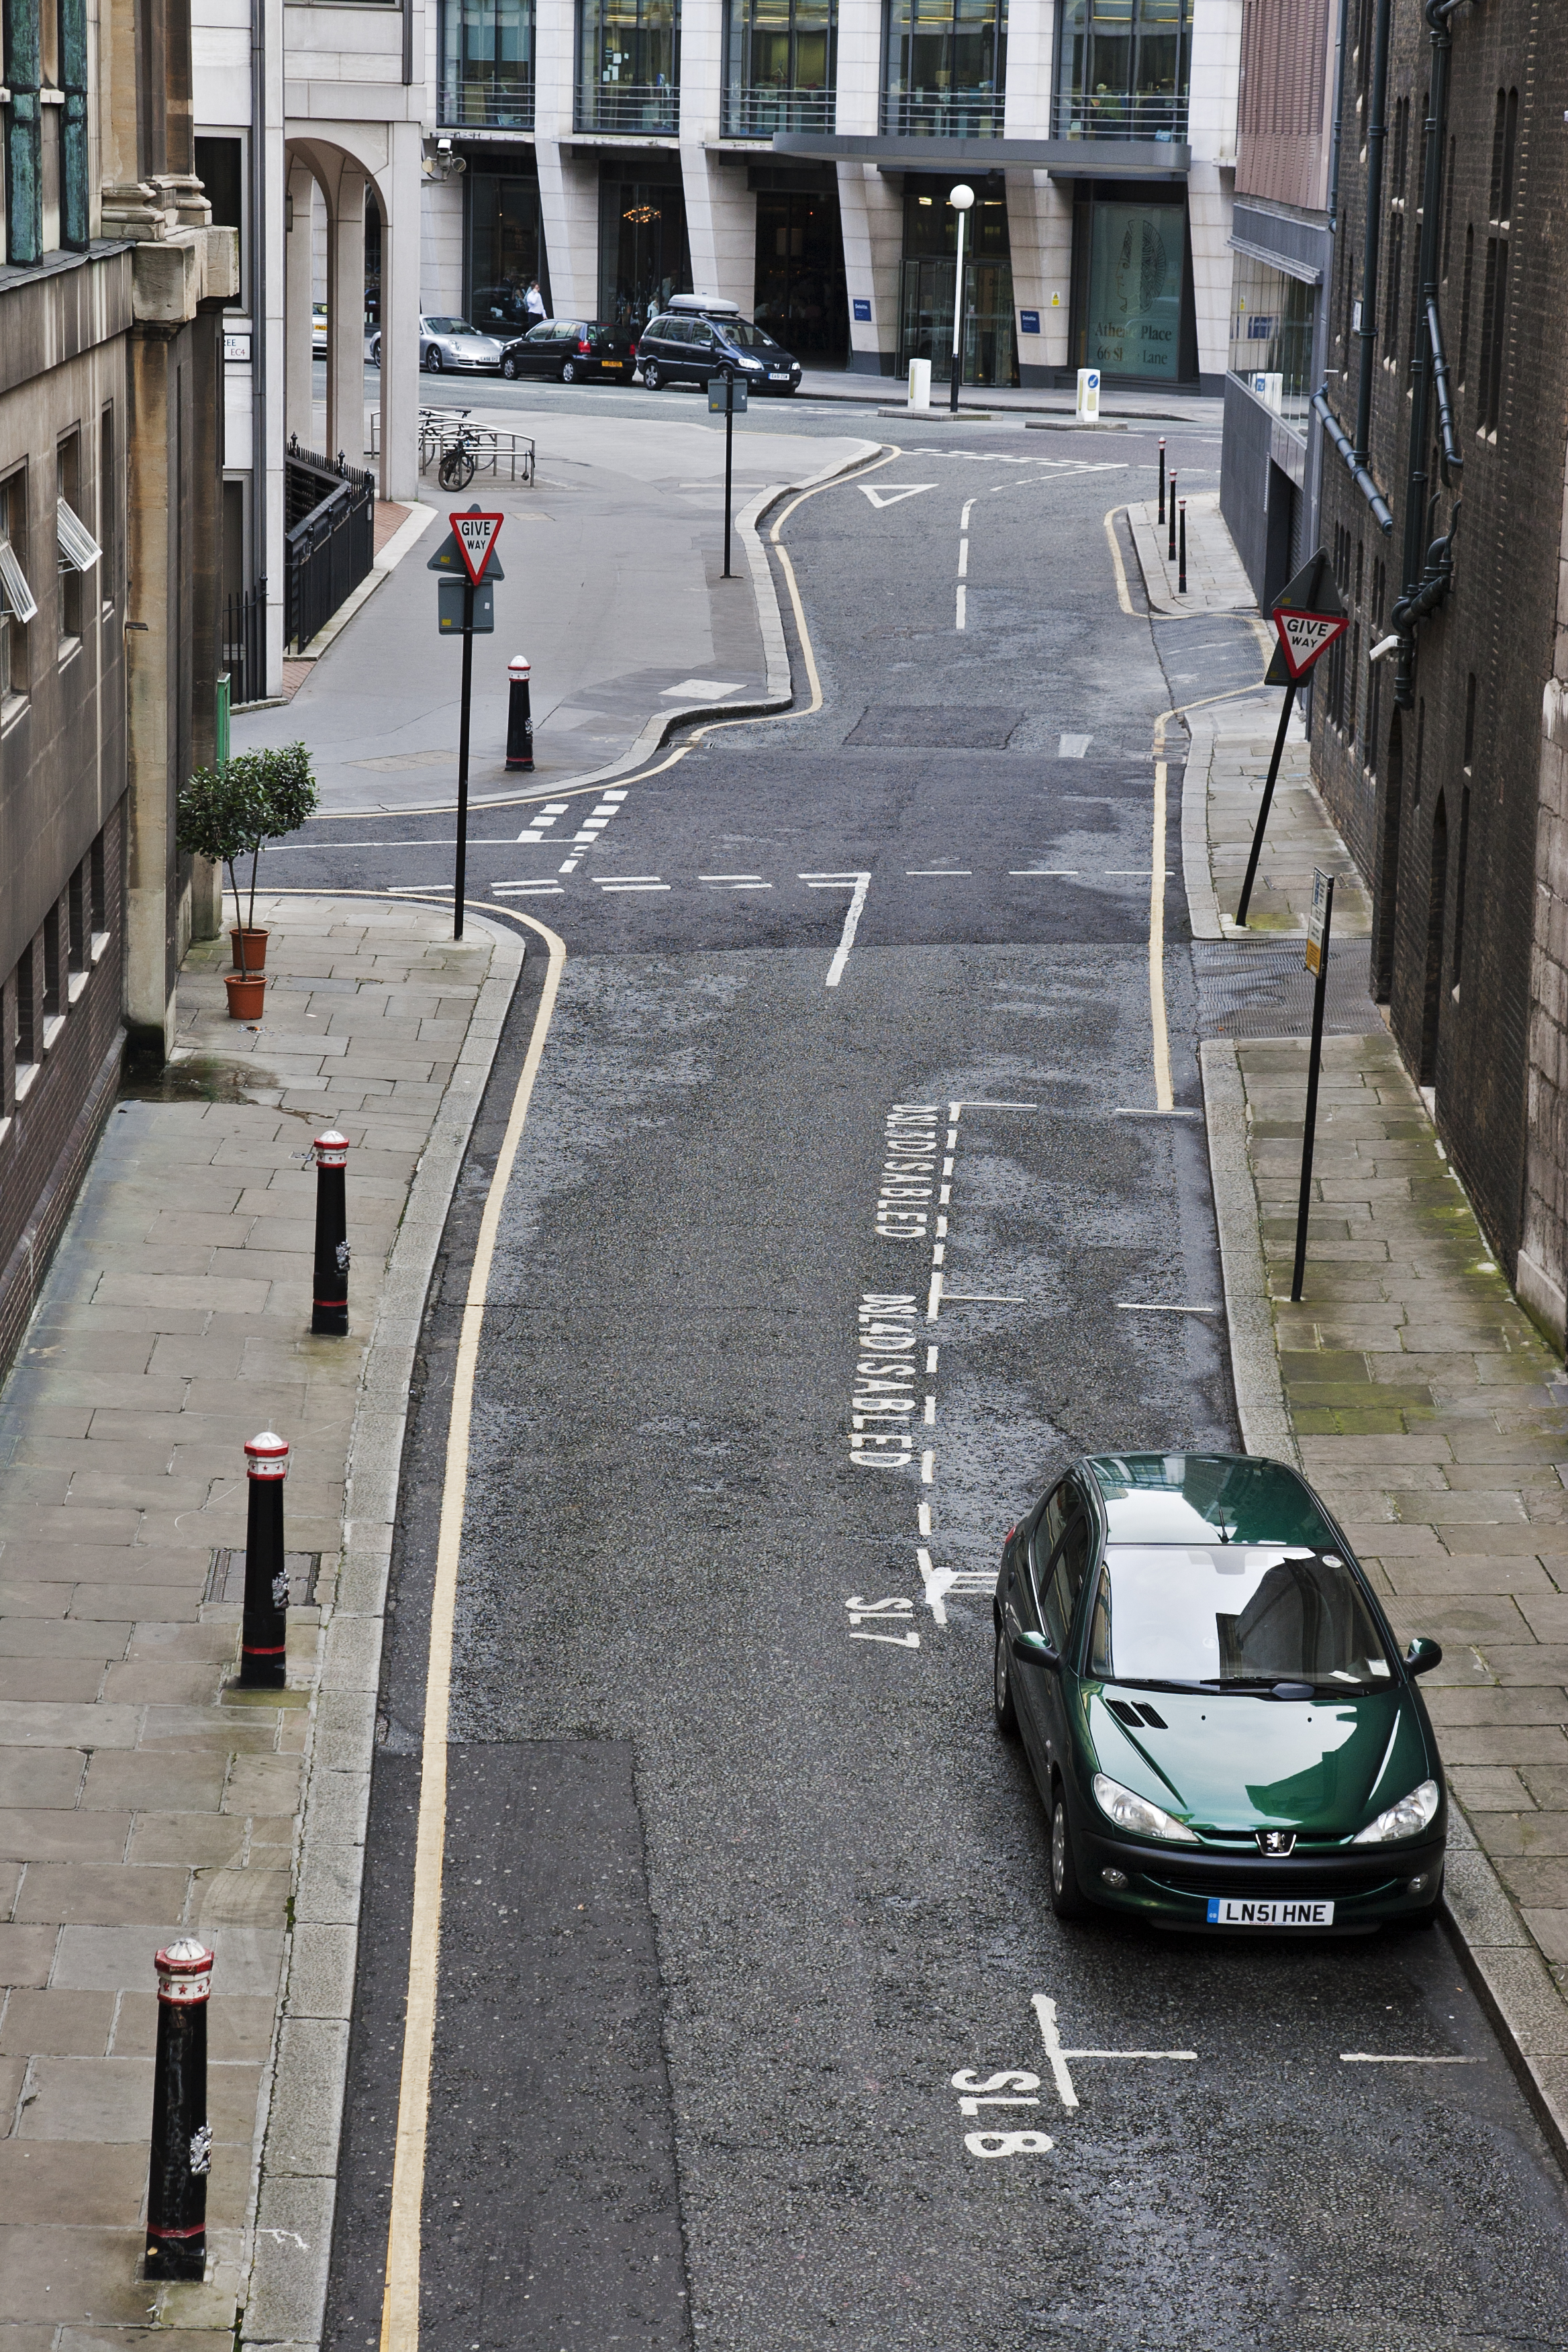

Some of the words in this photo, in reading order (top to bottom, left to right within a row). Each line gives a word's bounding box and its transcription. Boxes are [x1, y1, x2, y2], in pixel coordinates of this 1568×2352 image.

[1140, 324, 1172, 341] Place
[230, 348, 246, 356] EC4
[1097, 345, 1111, 360] 66
[1142, 349, 1168, 364] Lane
[461, 521, 491, 536] GIVE
[467, 540, 487, 550] WAY
[1287, 618, 1329, 637] GIVE
[1291, 636, 1318, 648] WAY
[1226, 1903, 1277, 1922] LN51
[1282, 1904, 1326, 1922] HNE
